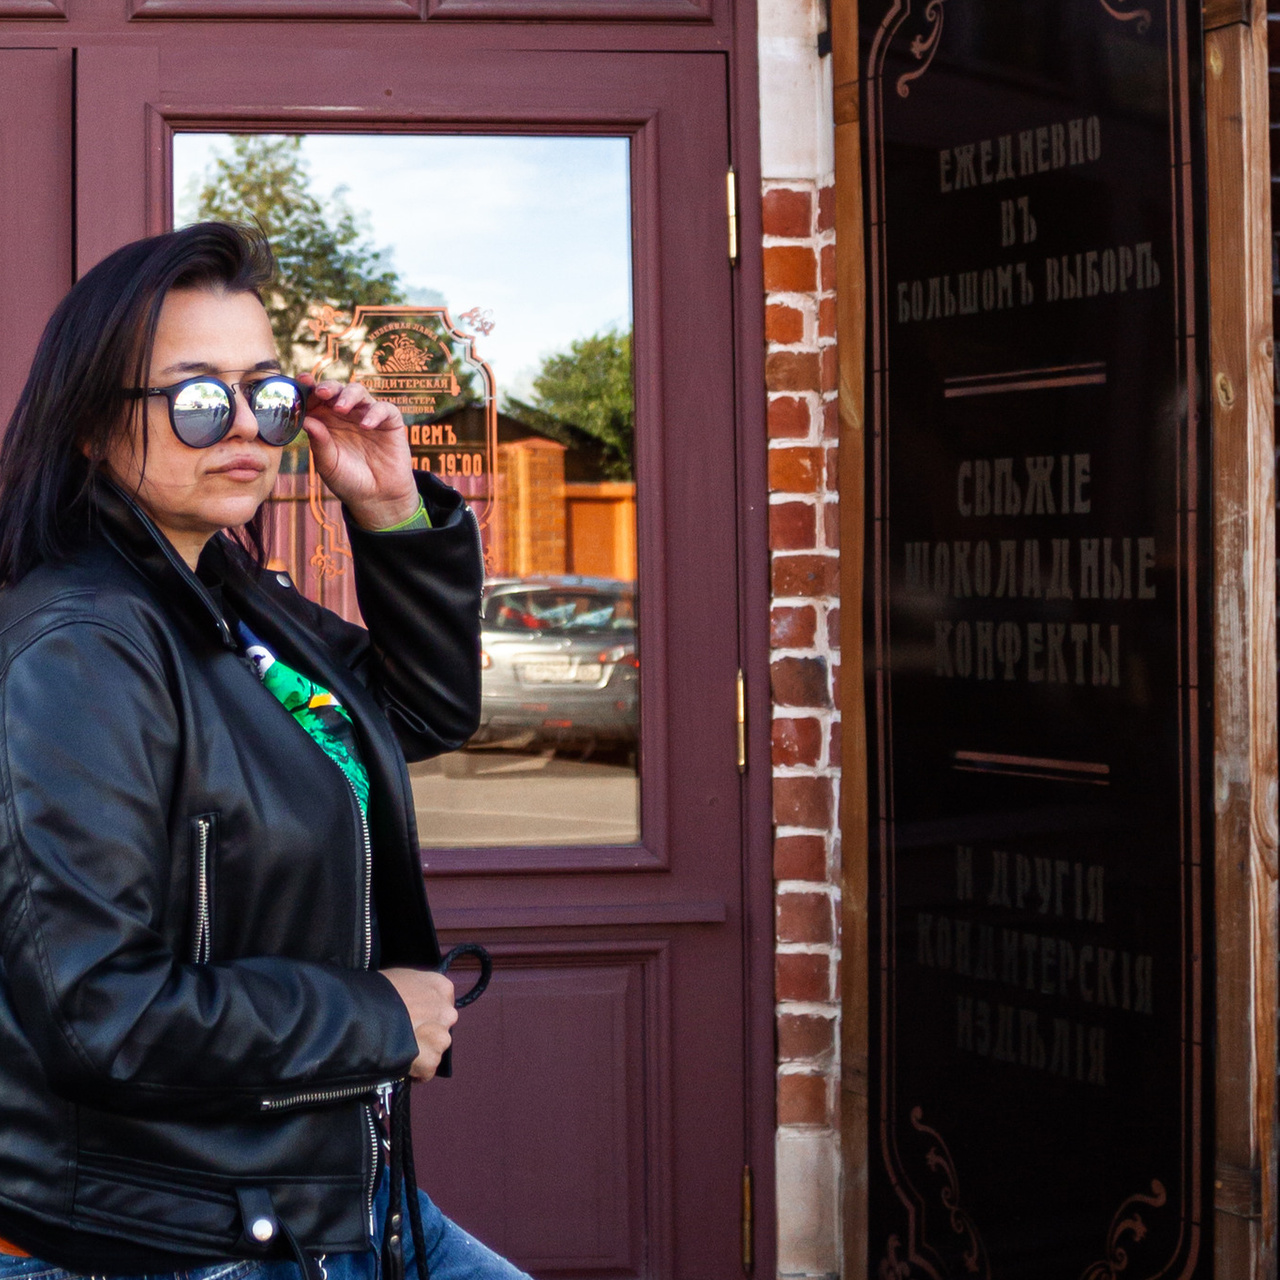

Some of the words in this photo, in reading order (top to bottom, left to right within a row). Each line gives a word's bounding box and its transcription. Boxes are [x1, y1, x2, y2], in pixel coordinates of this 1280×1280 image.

[939, 115, 1102, 194] ЕЖЕДНЕВНО
[1000, 195, 1038, 248] ВЪ
[896, 261, 1035, 324] БОЛЬШОМЪ
[438, 453, 483, 477] 19:00
